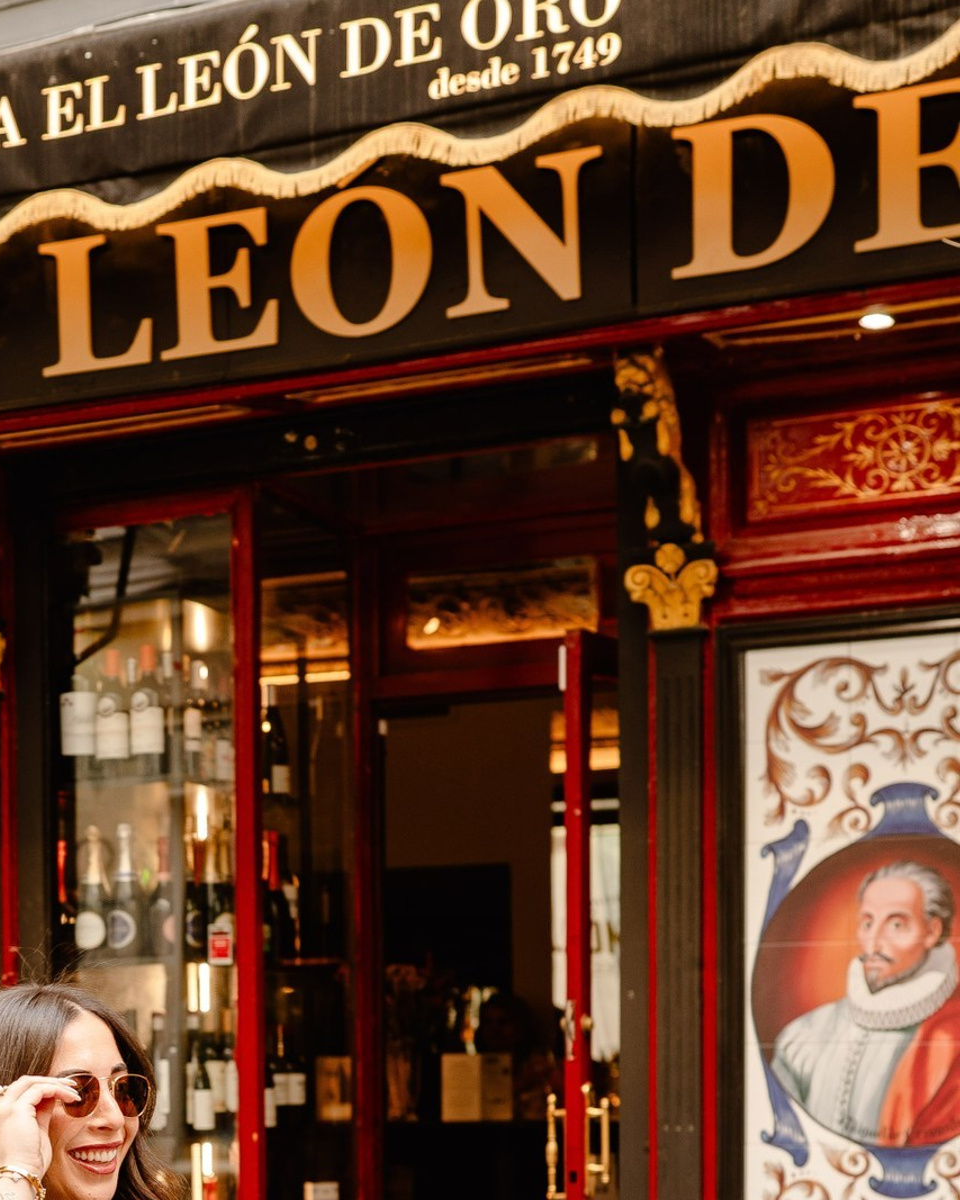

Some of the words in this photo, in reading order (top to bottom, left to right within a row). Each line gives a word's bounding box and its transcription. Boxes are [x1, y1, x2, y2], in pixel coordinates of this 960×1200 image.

[41, 75, 126, 142] EL
[136, 24, 323, 120] LEÓN
[340, 3, 443, 79] DE
[427, 56, 521, 100] desde
[531, 32, 623, 80] 1749
[671, 77, 960, 280] DE
